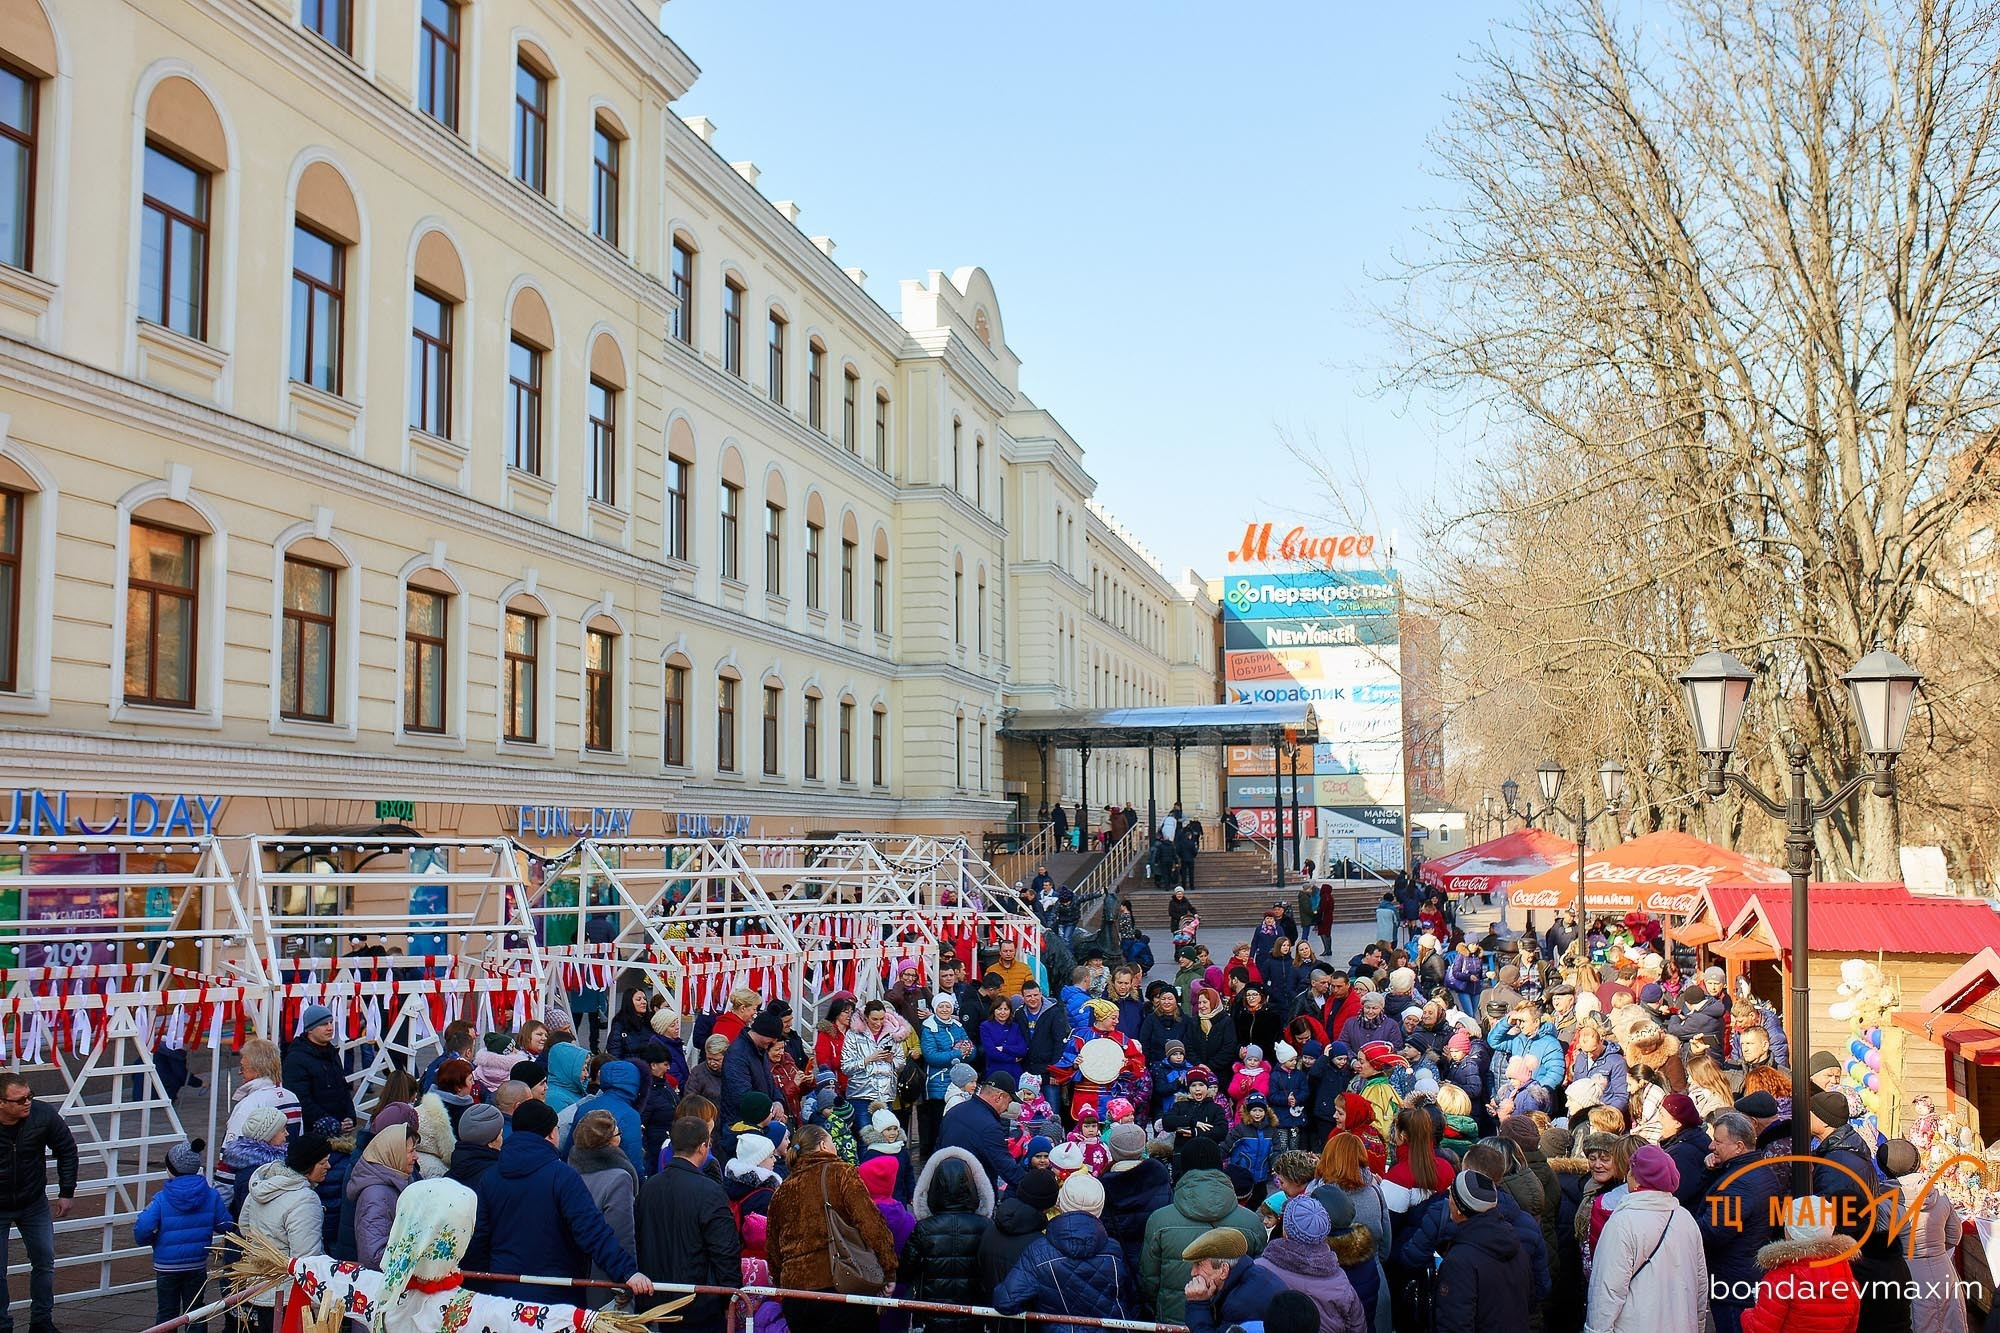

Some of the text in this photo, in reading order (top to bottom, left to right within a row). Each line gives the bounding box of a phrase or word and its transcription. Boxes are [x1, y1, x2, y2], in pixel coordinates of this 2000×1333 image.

[1236, 663, 1272, 676] ОБУВИ
[1254, 686, 1345, 704] кораблик
[1233, 748, 1276, 760] DNS
[128, 793, 222, 837] DAY
[380, 801, 415, 821] ВХОД
[1364, 809, 1400, 818] MANGO
[519, 806, 634, 838] FUN DAY
[676, 813, 752, 838] FUN DAY
